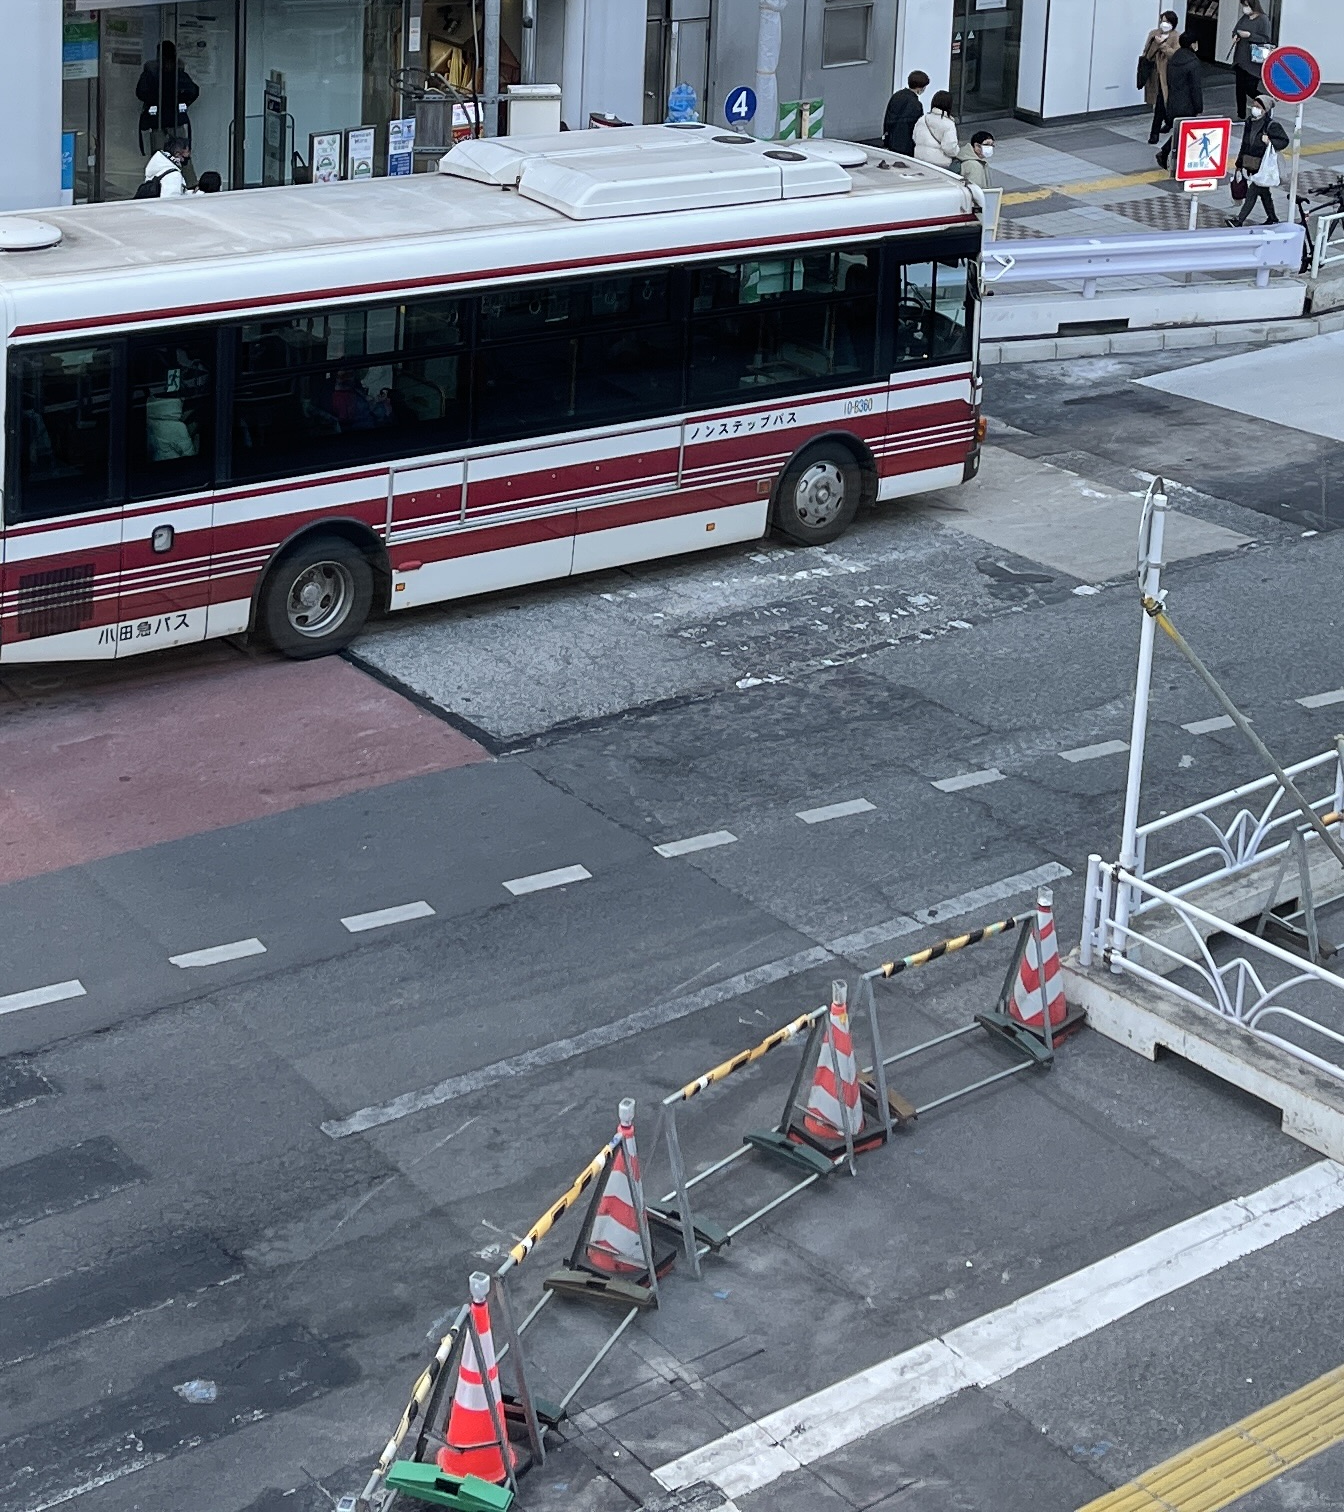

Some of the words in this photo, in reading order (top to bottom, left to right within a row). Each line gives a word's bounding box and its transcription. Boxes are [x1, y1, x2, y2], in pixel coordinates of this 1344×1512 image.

[732, 90, 748, 117] 4
[843, 397, 873, 416] 10-B360
[690, 411, 797, 440] ノンステップバス
[98, 613, 190, 646] 小田急バス
